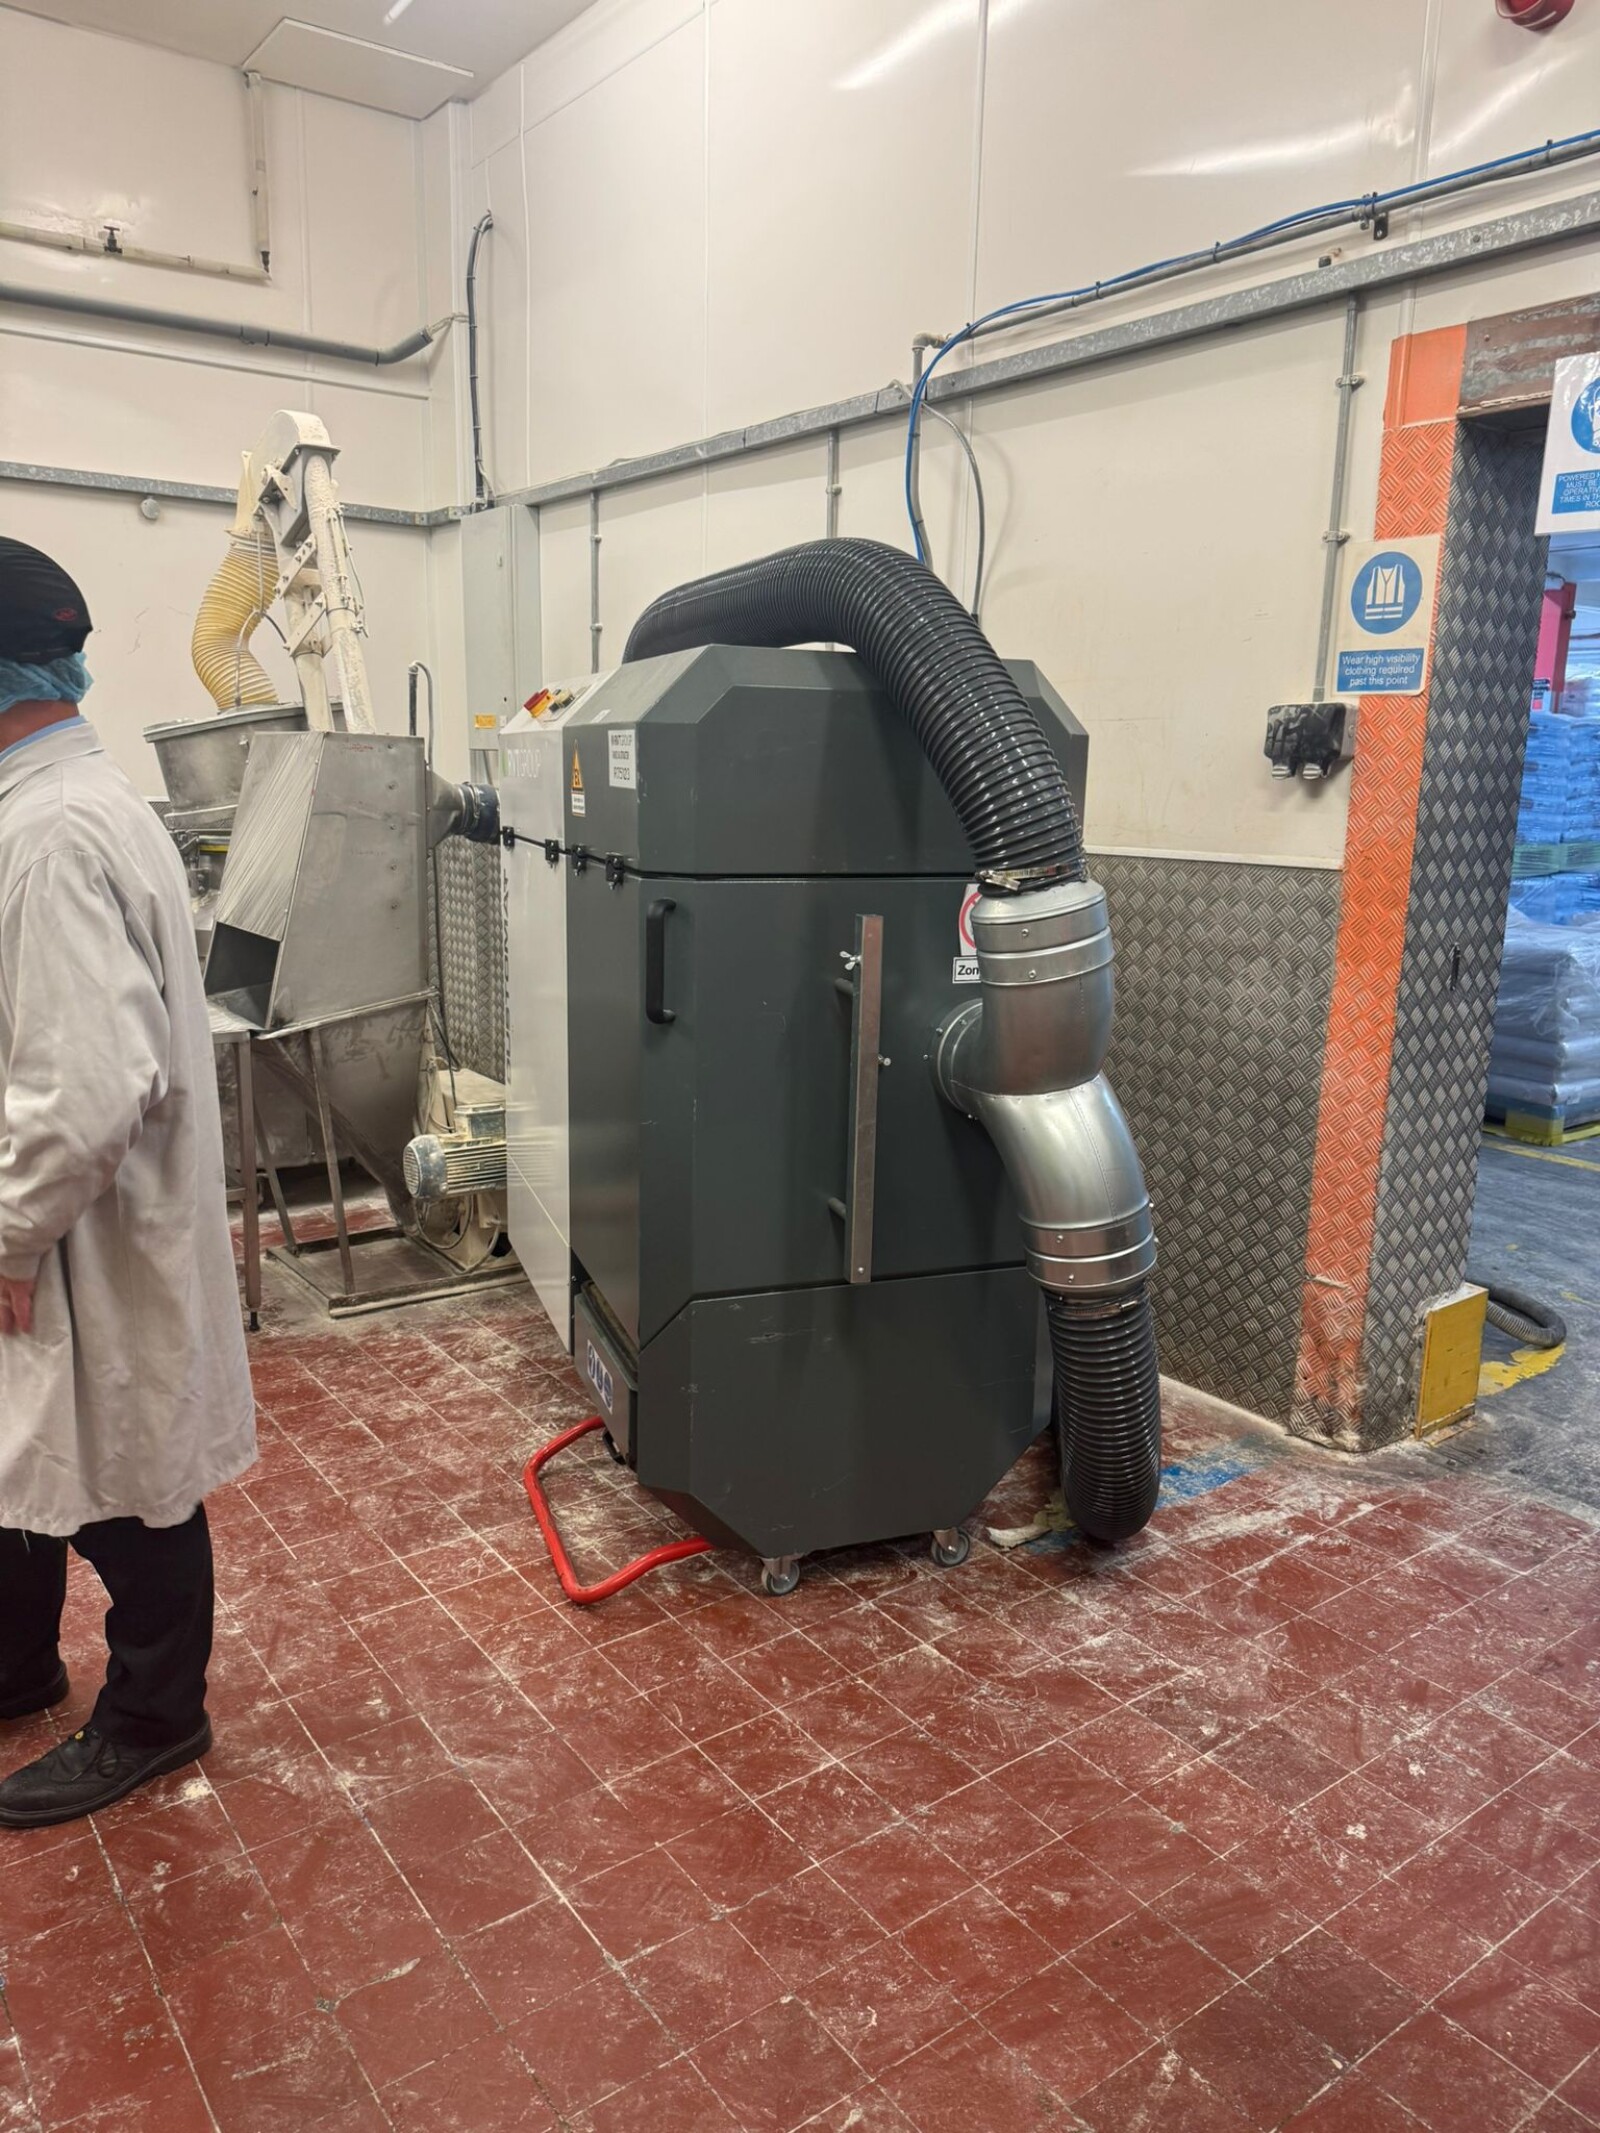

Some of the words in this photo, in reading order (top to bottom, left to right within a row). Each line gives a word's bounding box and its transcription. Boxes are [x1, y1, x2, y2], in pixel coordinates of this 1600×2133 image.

[1558, 472, 1595, 482] POWERED
[1563, 486, 1600, 496] OPERATIV
[1559, 495, 1581, 503] TIMES
[1342, 656, 1364, 665] Wear
[1365, 655, 1384, 666] high
[1386, 653, 1421, 665] visibility
[1344, 667, 1376, 677] clothing
[1379, 665, 1415, 676] required
[1349, 678, 1367, 688] past
[1369, 677, 1384, 685] this
[1385, 676, 1408, 687] point
[957, 964, 979, 975] Zon
